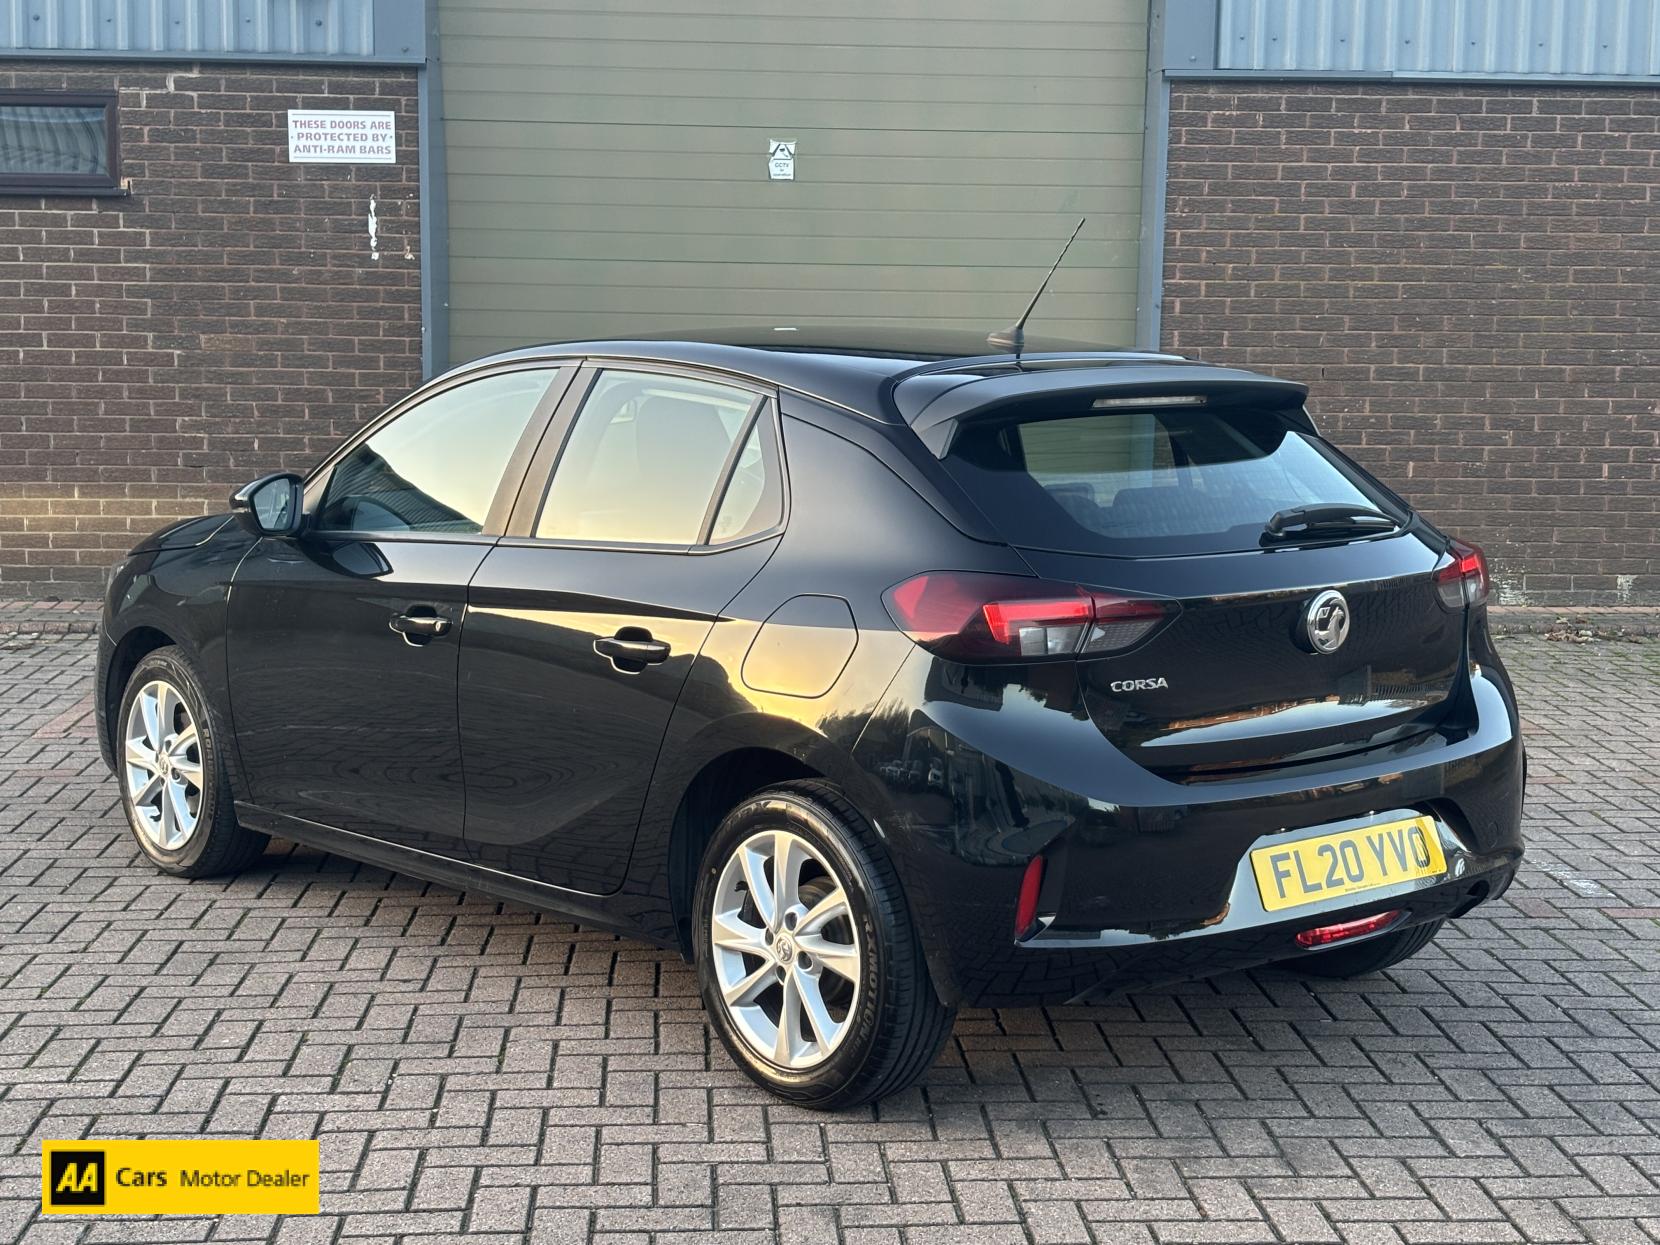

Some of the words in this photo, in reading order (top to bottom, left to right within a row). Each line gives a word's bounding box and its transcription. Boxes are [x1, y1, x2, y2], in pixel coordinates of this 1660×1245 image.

[292, 120, 327, 129] THESE
[330, 120, 366, 129] DOORS
[370, 121, 391, 130] ARE
[297, 132, 368, 142] PROTECTED
[371, 133, 388, 142] BY
[294, 145, 356, 154] ANTI-RAM
[359, 145, 391, 155] BARS
[1110, 677, 1168, 692] CORSA
[1269, 839, 1365, 899] FL20
